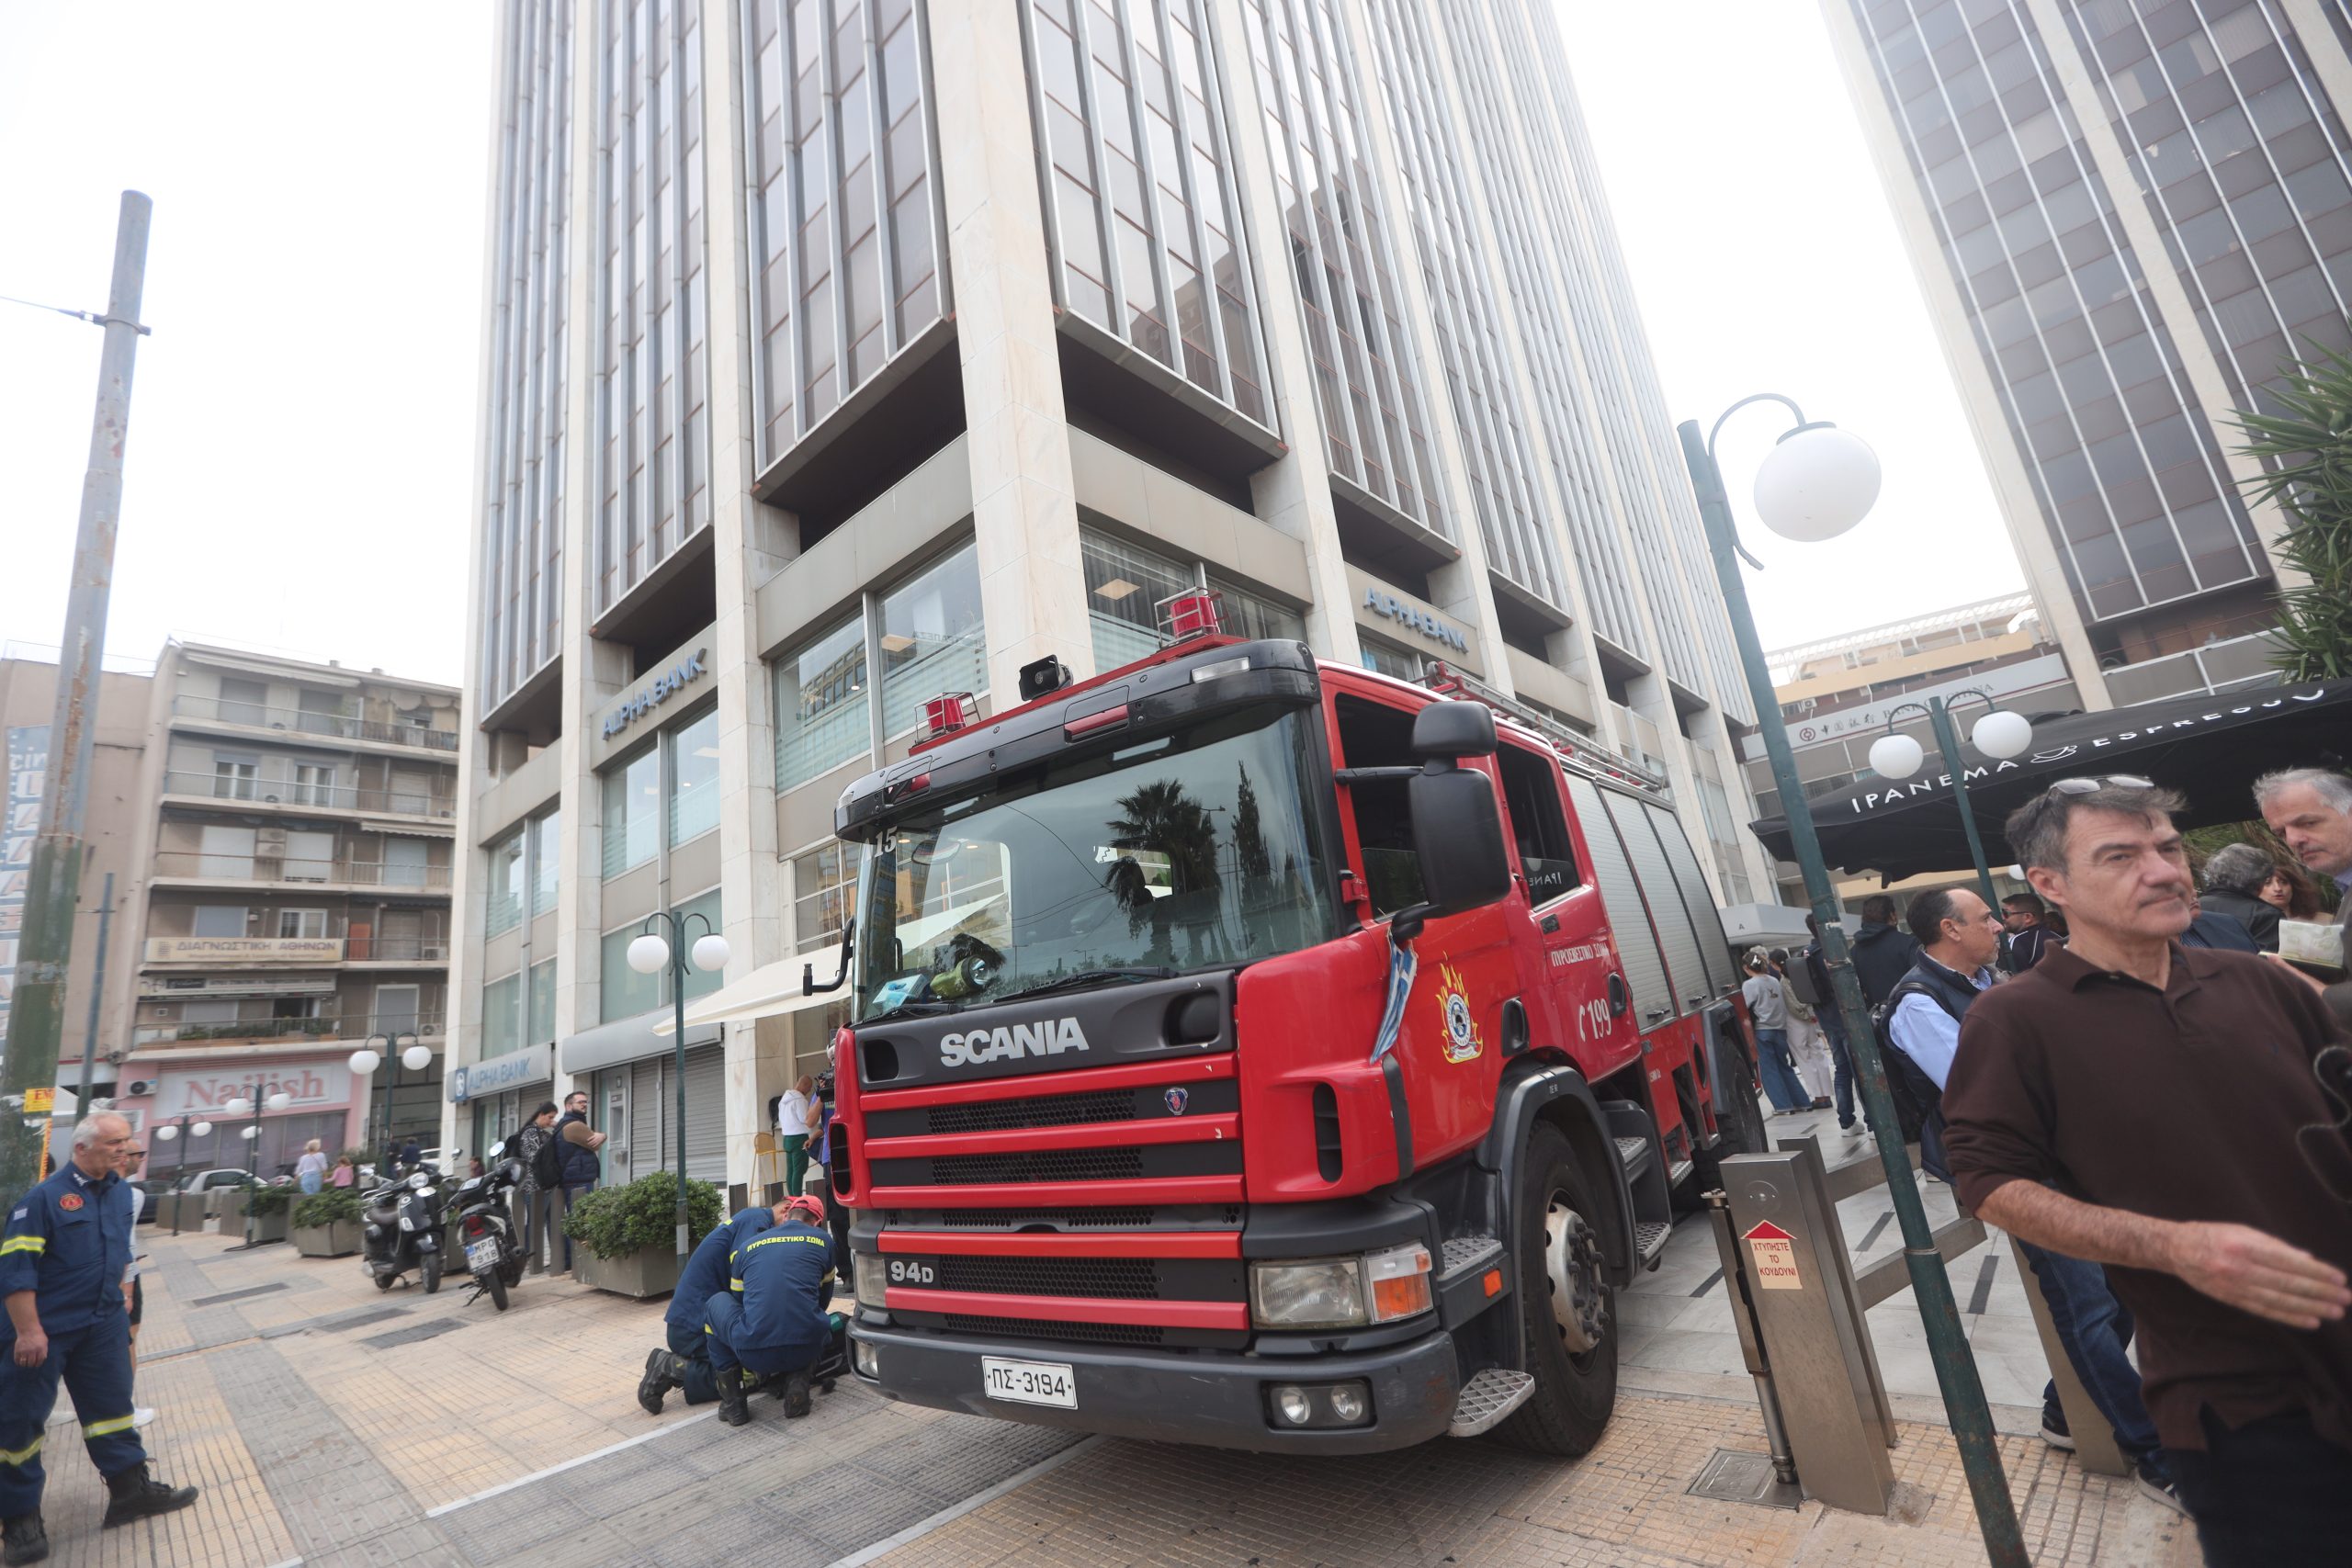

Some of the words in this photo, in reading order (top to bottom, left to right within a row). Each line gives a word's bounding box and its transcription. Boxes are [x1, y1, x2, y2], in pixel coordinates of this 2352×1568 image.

[1363, 588, 1423, 634] ALPHA
[1422, 613, 1468, 654] BANK
[603, 688, 656, 740] ALPHA
[654, 648, 707, 705] BANK
[1851, 761, 2019, 813] IPANEMA
[176, 942, 272, 951] ΔΙΑΓΝΩΣΤΙΚΗ
[278, 942, 336, 951] ΑΘΗΝΩΝ
[1588, 998, 1612, 1040] 199
[940, 1016, 1090, 1067] SCANIA
[183, 1069, 324, 1108] Nailish
[469, 1067, 500, 1090] ALPHA
[501, 1056, 531, 1083] BANK
[747, 1235, 805, 1252] ΠΥΡΟΣΒΕΣΤΙΚΟ
[806, 1235, 825, 1247] ΣΩΜΑ
[1753, 1242, 1790, 1251] ΧΤΥΠΗΣΤΕ
[1769, 1255, 1780, 1263] ΤΟ
[890, 1260, 934, 1283] 94D
[1759, 1267, 1797, 1277] ΚΟΥΔΟΥΝΙ
[991, 1368, 1066, 1397] ΠΣ-3194
